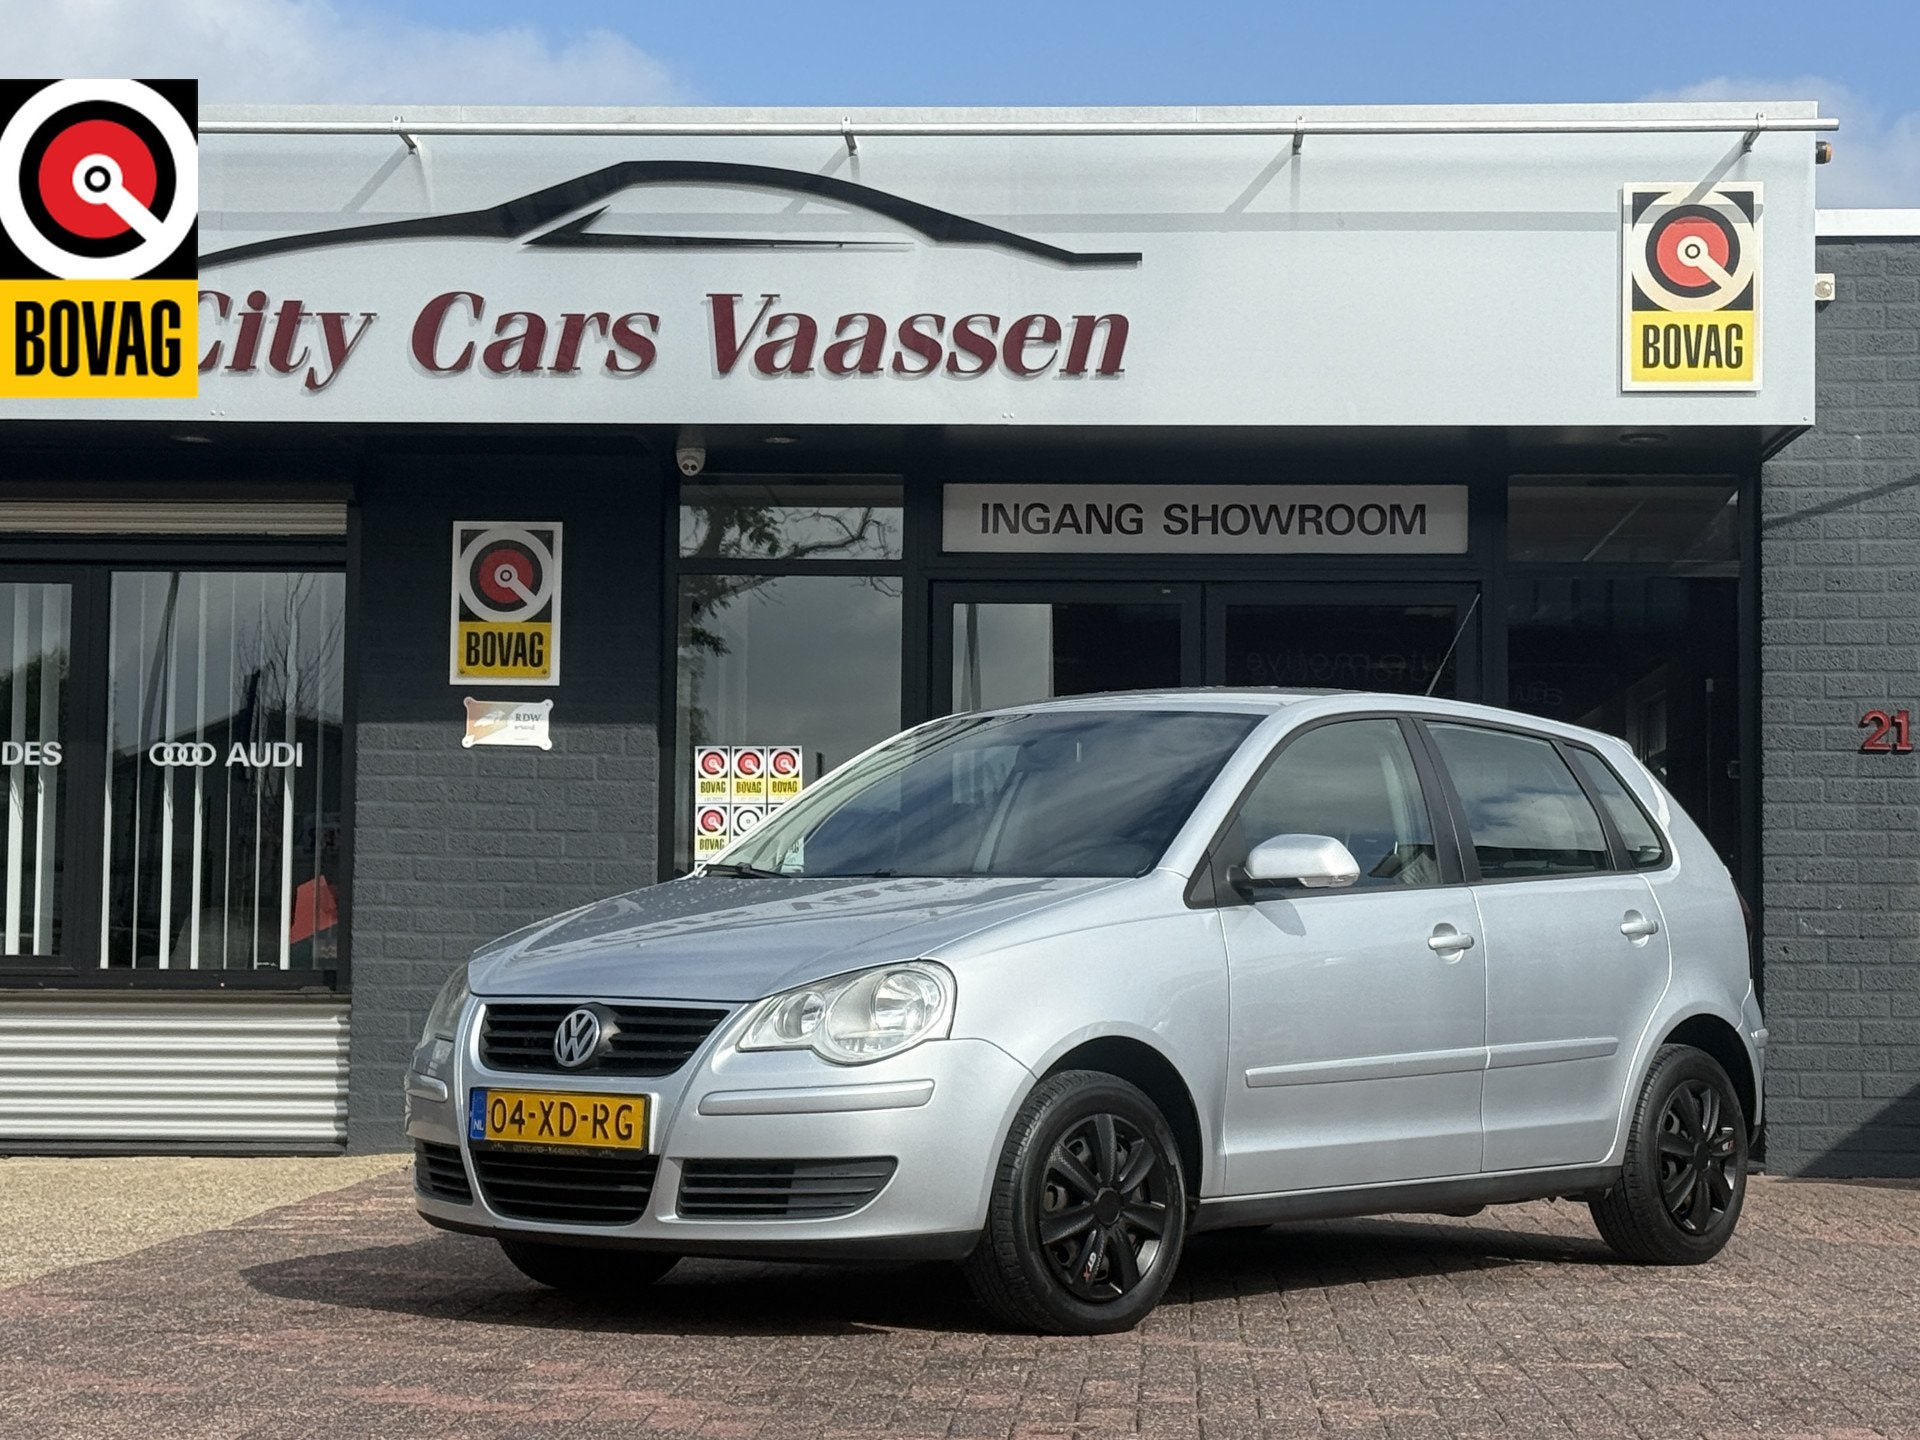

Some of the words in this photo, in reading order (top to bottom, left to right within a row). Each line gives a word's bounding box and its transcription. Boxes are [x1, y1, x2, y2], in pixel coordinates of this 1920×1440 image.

[411, 291, 659, 374] Cars
[705, 293, 1130, 376] Vaassen
[1642, 323, 1743, 369] BOVAG
[981, 502, 1144, 536] INGANG
[1163, 503, 1427, 536] SHOWROOM
[465, 631, 544, 668] BOVAG
[1860, 708, 1914, 752] 21
[1, 741, 63, 766] DES
[225, 742, 303, 767] AUDI
[700, 781, 726, 794] BOVAG
[736, 781, 762, 794] BOVAG
[771, 780, 798, 793] BOVAG
[491, 1097, 634, 1141] 04-XD-RG
